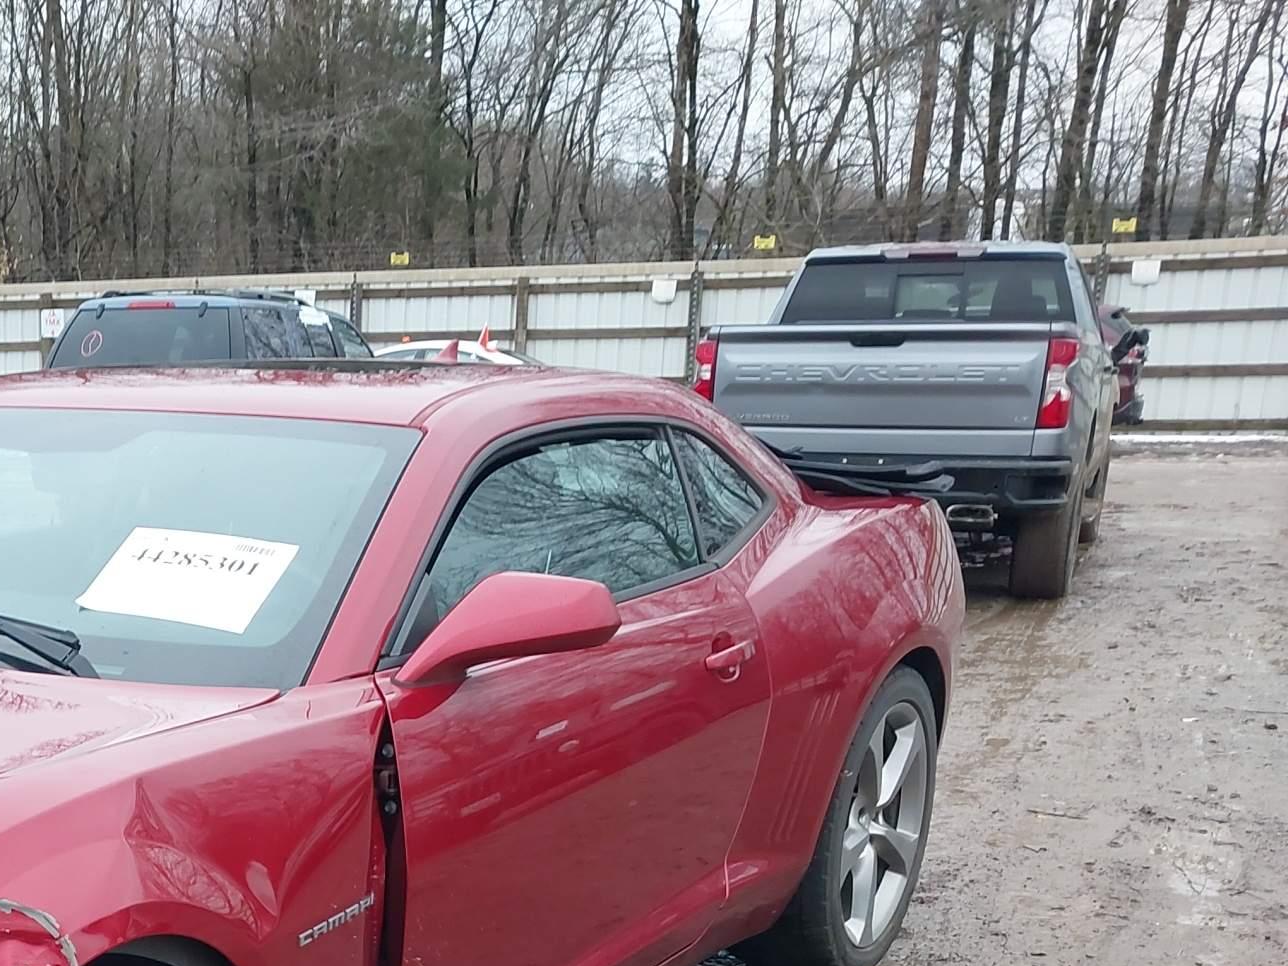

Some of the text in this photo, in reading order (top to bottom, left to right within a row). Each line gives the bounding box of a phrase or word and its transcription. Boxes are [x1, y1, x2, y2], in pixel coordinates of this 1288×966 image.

[735, 363, 1021, 382] CHEVROLET
[131, 547, 260, 577] 44285301
[298, 890, 374, 948] CAMAR
